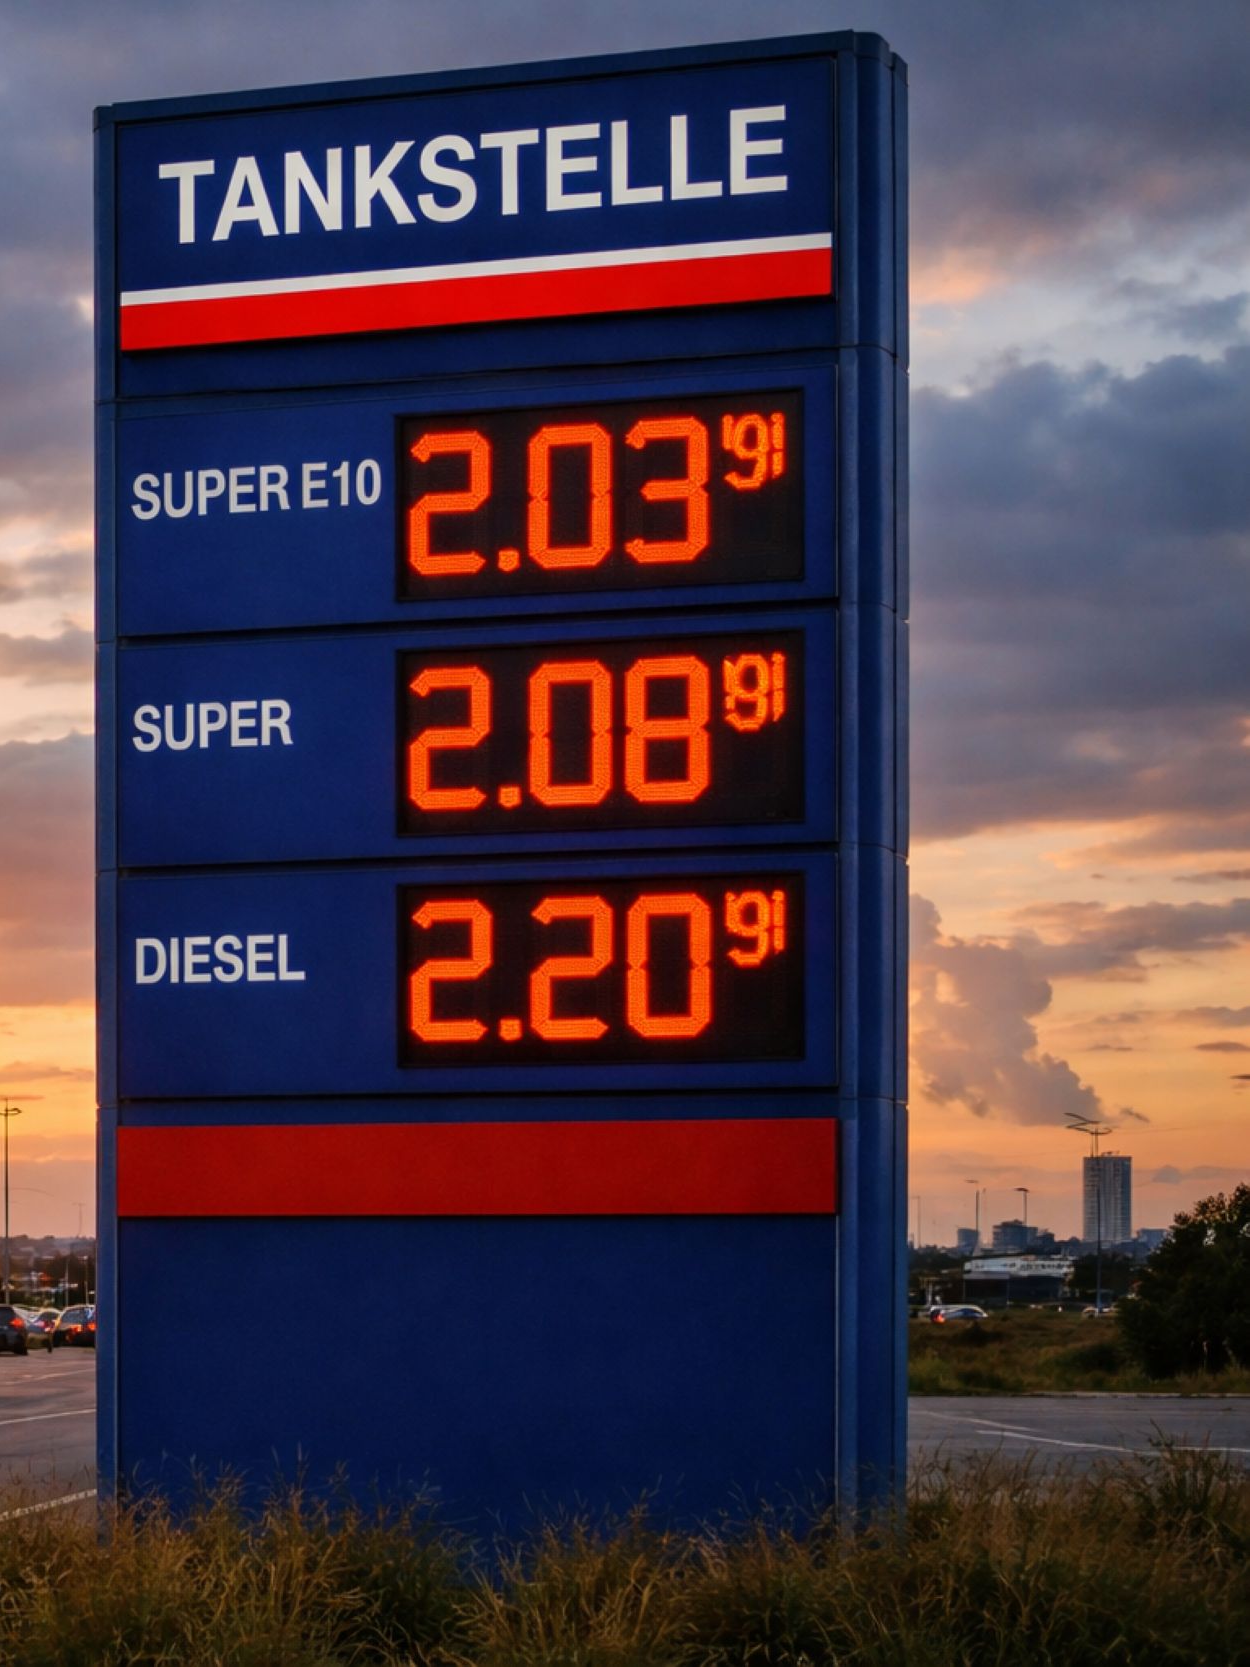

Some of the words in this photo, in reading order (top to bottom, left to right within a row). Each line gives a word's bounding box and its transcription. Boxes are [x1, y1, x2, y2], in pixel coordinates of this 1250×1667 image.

[158, 104, 789, 244] TANKSTELLE
[131, 464, 290, 520] SUPER
[302, 459, 381, 509] E10
[407, 415, 711, 577] 2.03
[132, 699, 293, 752] SUPER
[407, 654, 712, 812] 2.08
[135, 934, 305, 984] DIESEL
[408, 891, 714, 1043] 2.20
